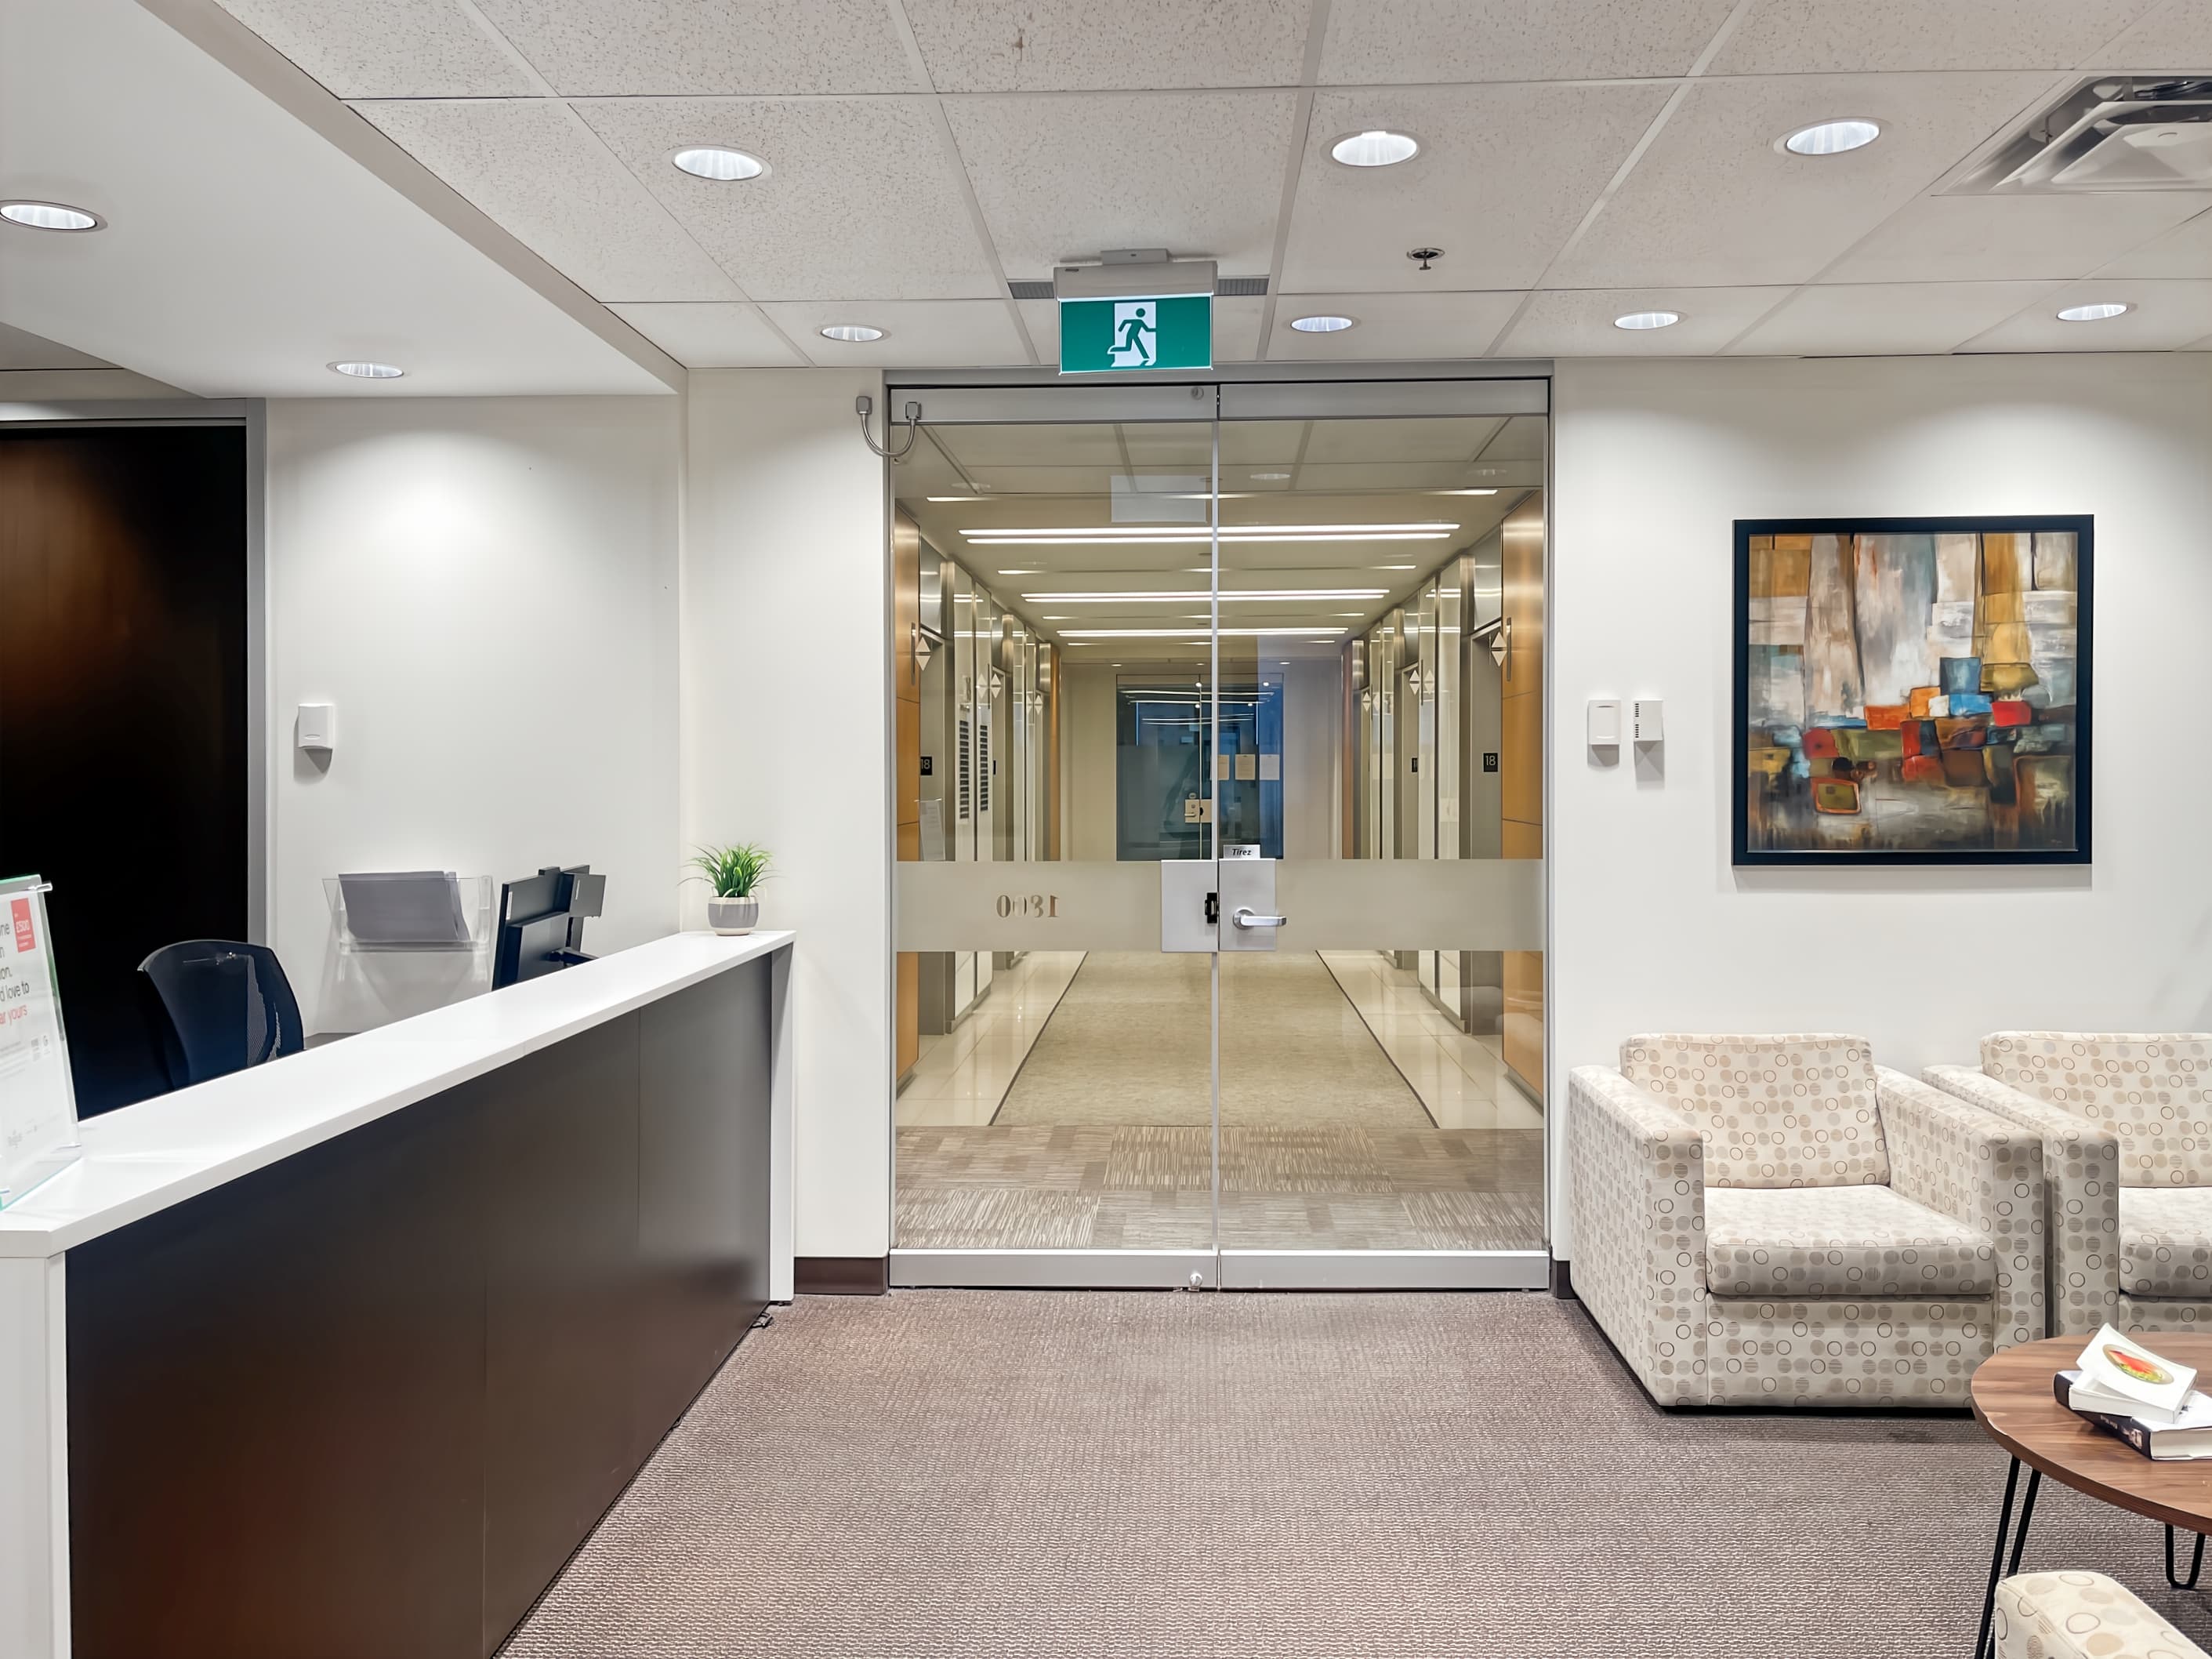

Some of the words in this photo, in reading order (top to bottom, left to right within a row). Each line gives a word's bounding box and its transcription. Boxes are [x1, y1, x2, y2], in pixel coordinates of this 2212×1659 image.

[920, 758, 930, 769] 18
[1485, 755, 1496, 766] 18
[5, 985, 20, 999] love
[21, 981, 30, 995] to
[8, 1004, 27, 1026] yours
